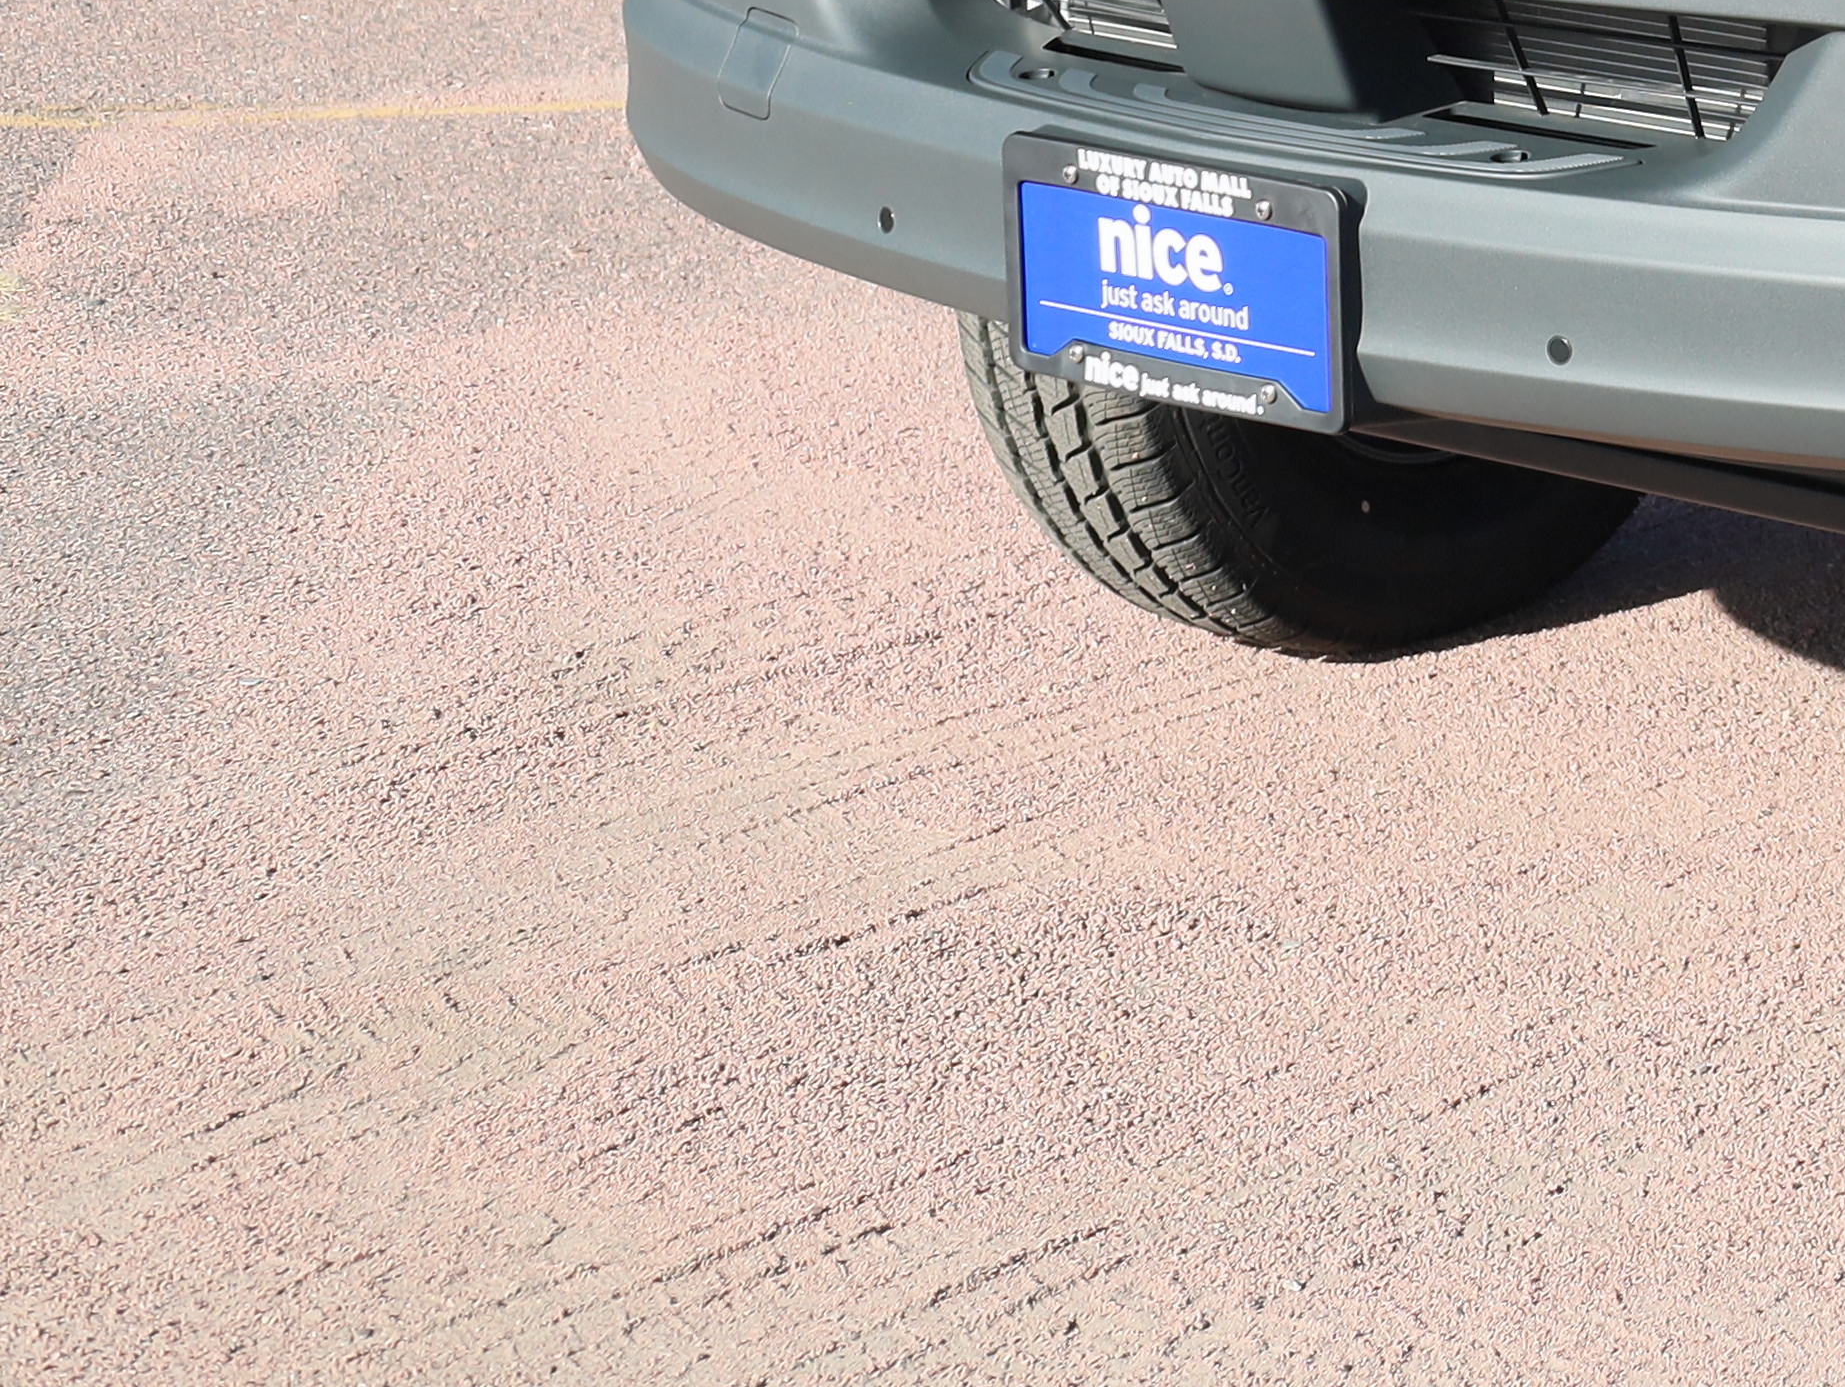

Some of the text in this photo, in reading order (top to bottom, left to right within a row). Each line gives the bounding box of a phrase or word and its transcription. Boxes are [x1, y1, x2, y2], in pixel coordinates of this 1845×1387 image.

[1077, 148, 1252, 200] LUXURY AUTO MALL
[1096, 173, 1234, 218] OF SIOUX FALLS
[1100, 278, 1249, 331] just ask around
[1108, 321, 1242, 364] SIOUX FALLS, S.D.
[1084, 350, 1140, 392] nice
[1139, 372, 1170, 398] just
[1171, 382, 1200, 404] ask
